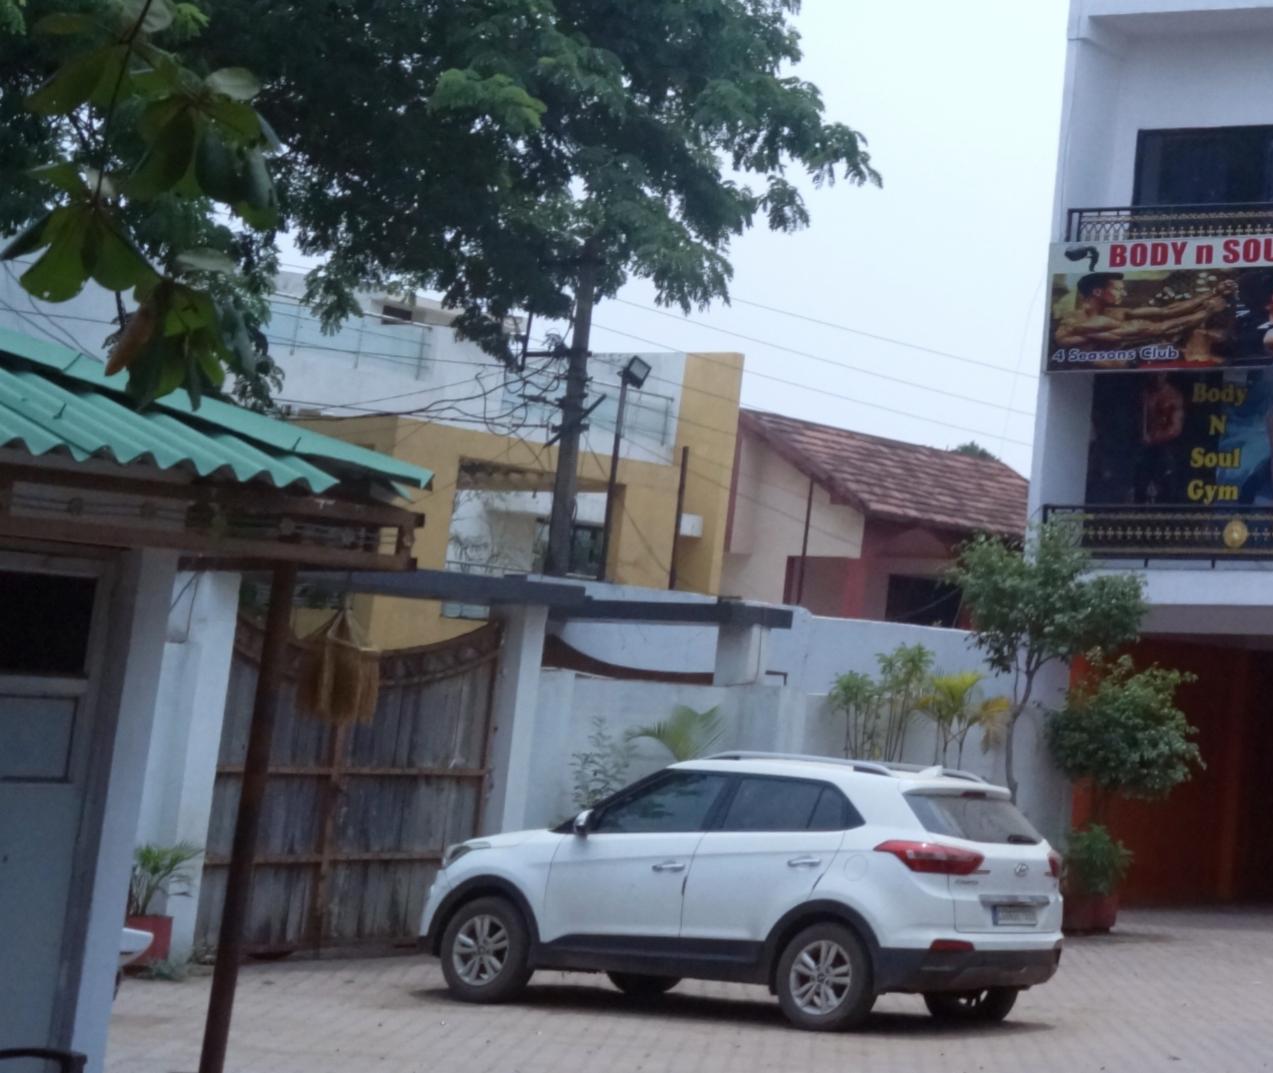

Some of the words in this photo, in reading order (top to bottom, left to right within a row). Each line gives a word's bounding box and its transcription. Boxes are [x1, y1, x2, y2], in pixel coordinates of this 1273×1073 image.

[1109, 241, 1187, 268] BODY
[1195, 244, 1213, 265] n
[1051, 349, 1066, 363] 4
[1068, 347, 1136, 363] Seasons
[1138, 343, 1180, 360] Club
[1192, 382, 1248, 407] Body
[1209, 414, 1227, 436] N
[1190, 447, 1241, 468] Soul
[1187, 479, 1239, 505] Gym
